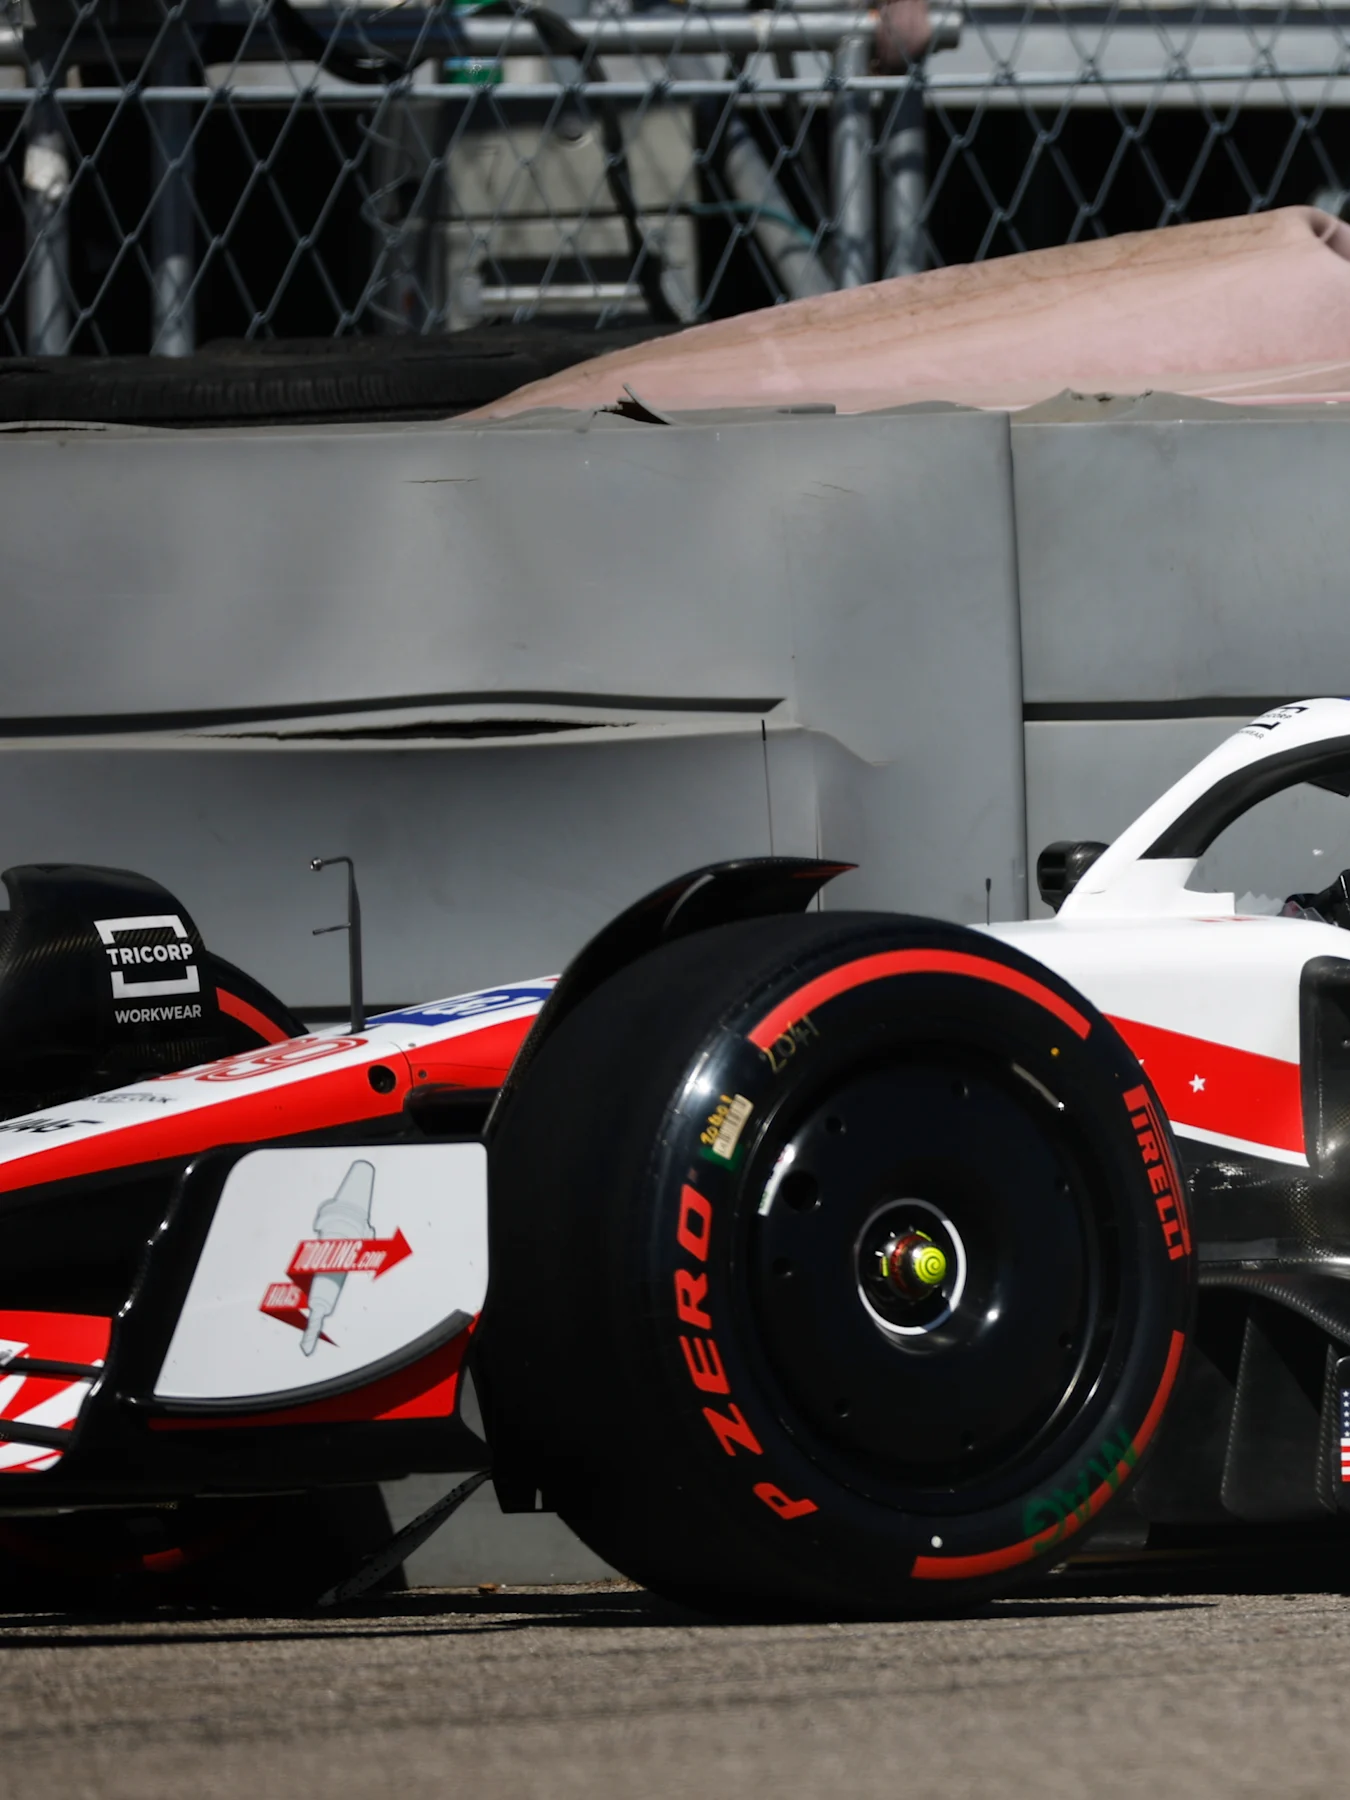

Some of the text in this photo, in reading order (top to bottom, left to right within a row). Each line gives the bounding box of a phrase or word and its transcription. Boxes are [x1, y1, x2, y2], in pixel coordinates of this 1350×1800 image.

[106, 943, 194, 966] TRICORP
[114, 1004, 202, 1024] WORKWEAR
[1122, 1084, 1192, 1261] PIRELLI
[675, 1183, 819, 1520] P ZERO
